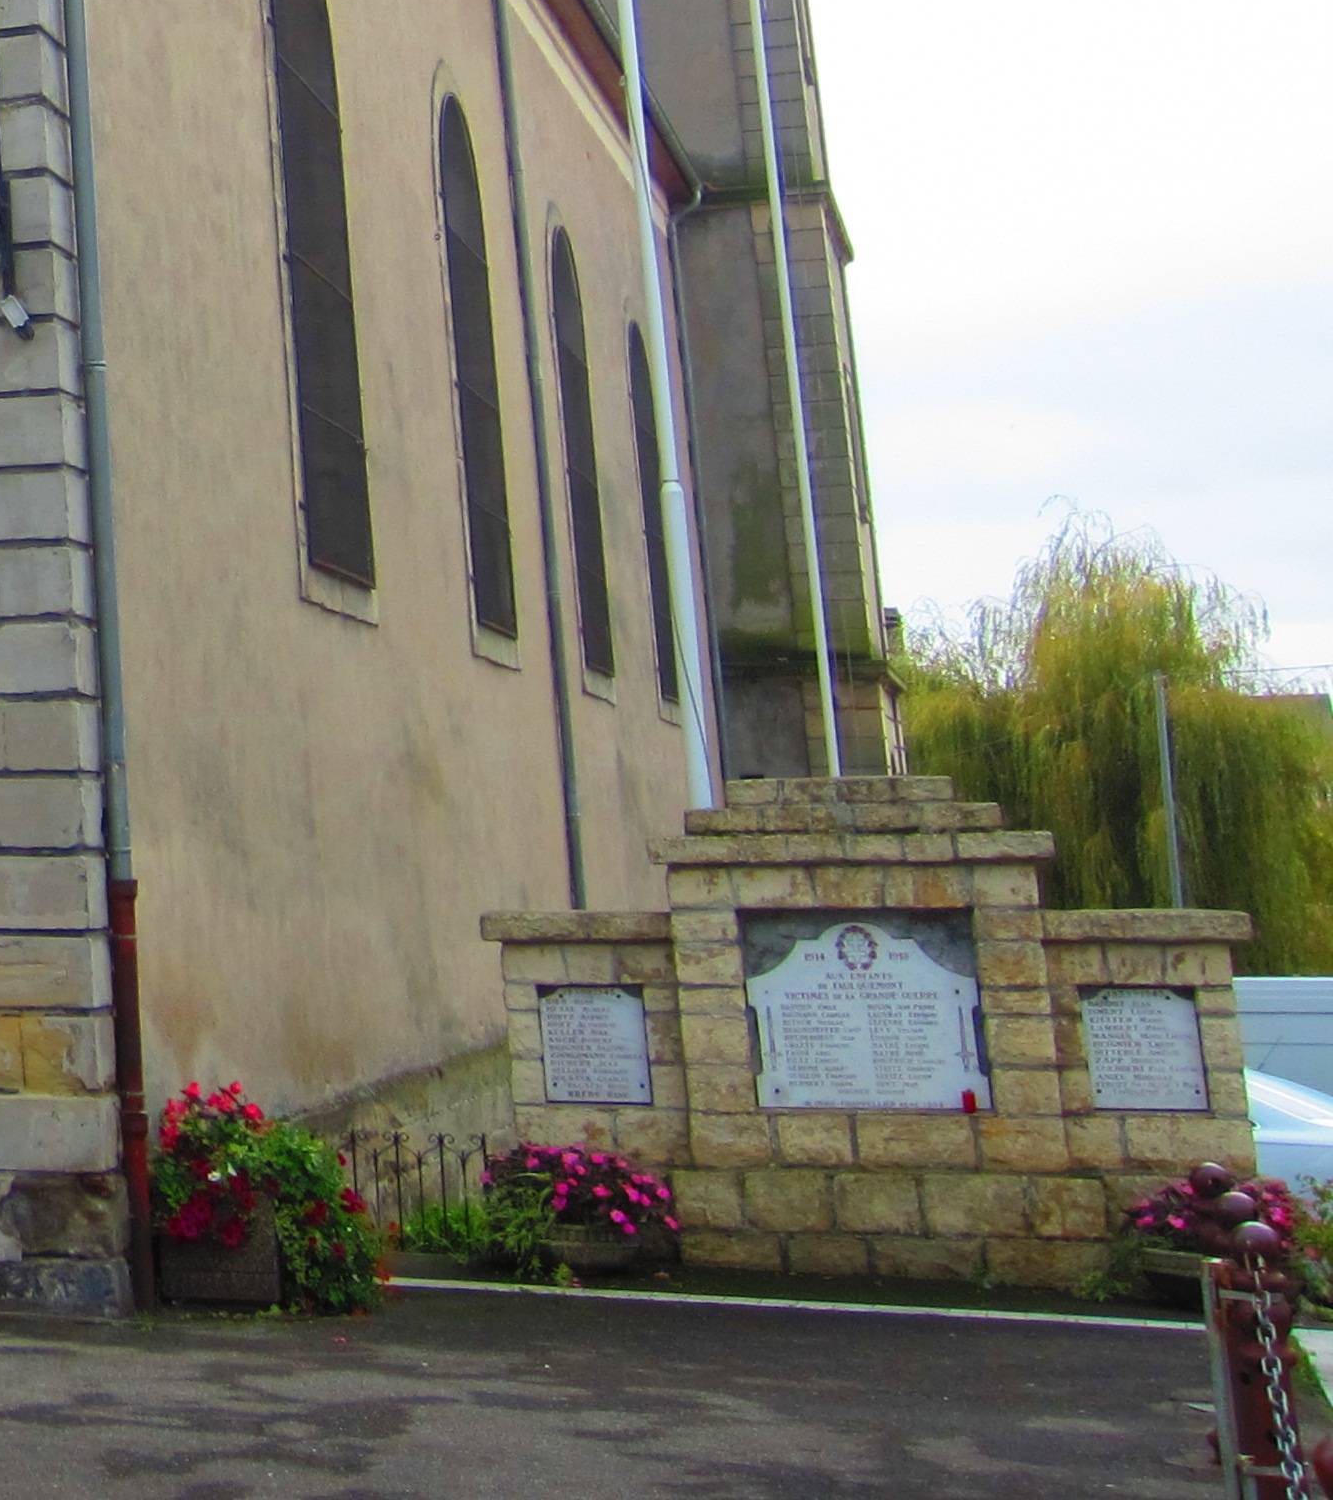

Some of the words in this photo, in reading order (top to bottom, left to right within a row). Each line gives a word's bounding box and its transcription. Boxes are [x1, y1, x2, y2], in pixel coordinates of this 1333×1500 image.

[804, 952, 825, 961] 1914
[825, 972, 845, 980] AUX
[850, 972, 893, 980] ENFANTS
[832, 981, 903, 990] FAULQUEMONT
[784, 991, 829, 1000] VICTIMES
[859, 991, 897, 1000] GRANDE
[901, 991, 939, 1000] GUERRE
